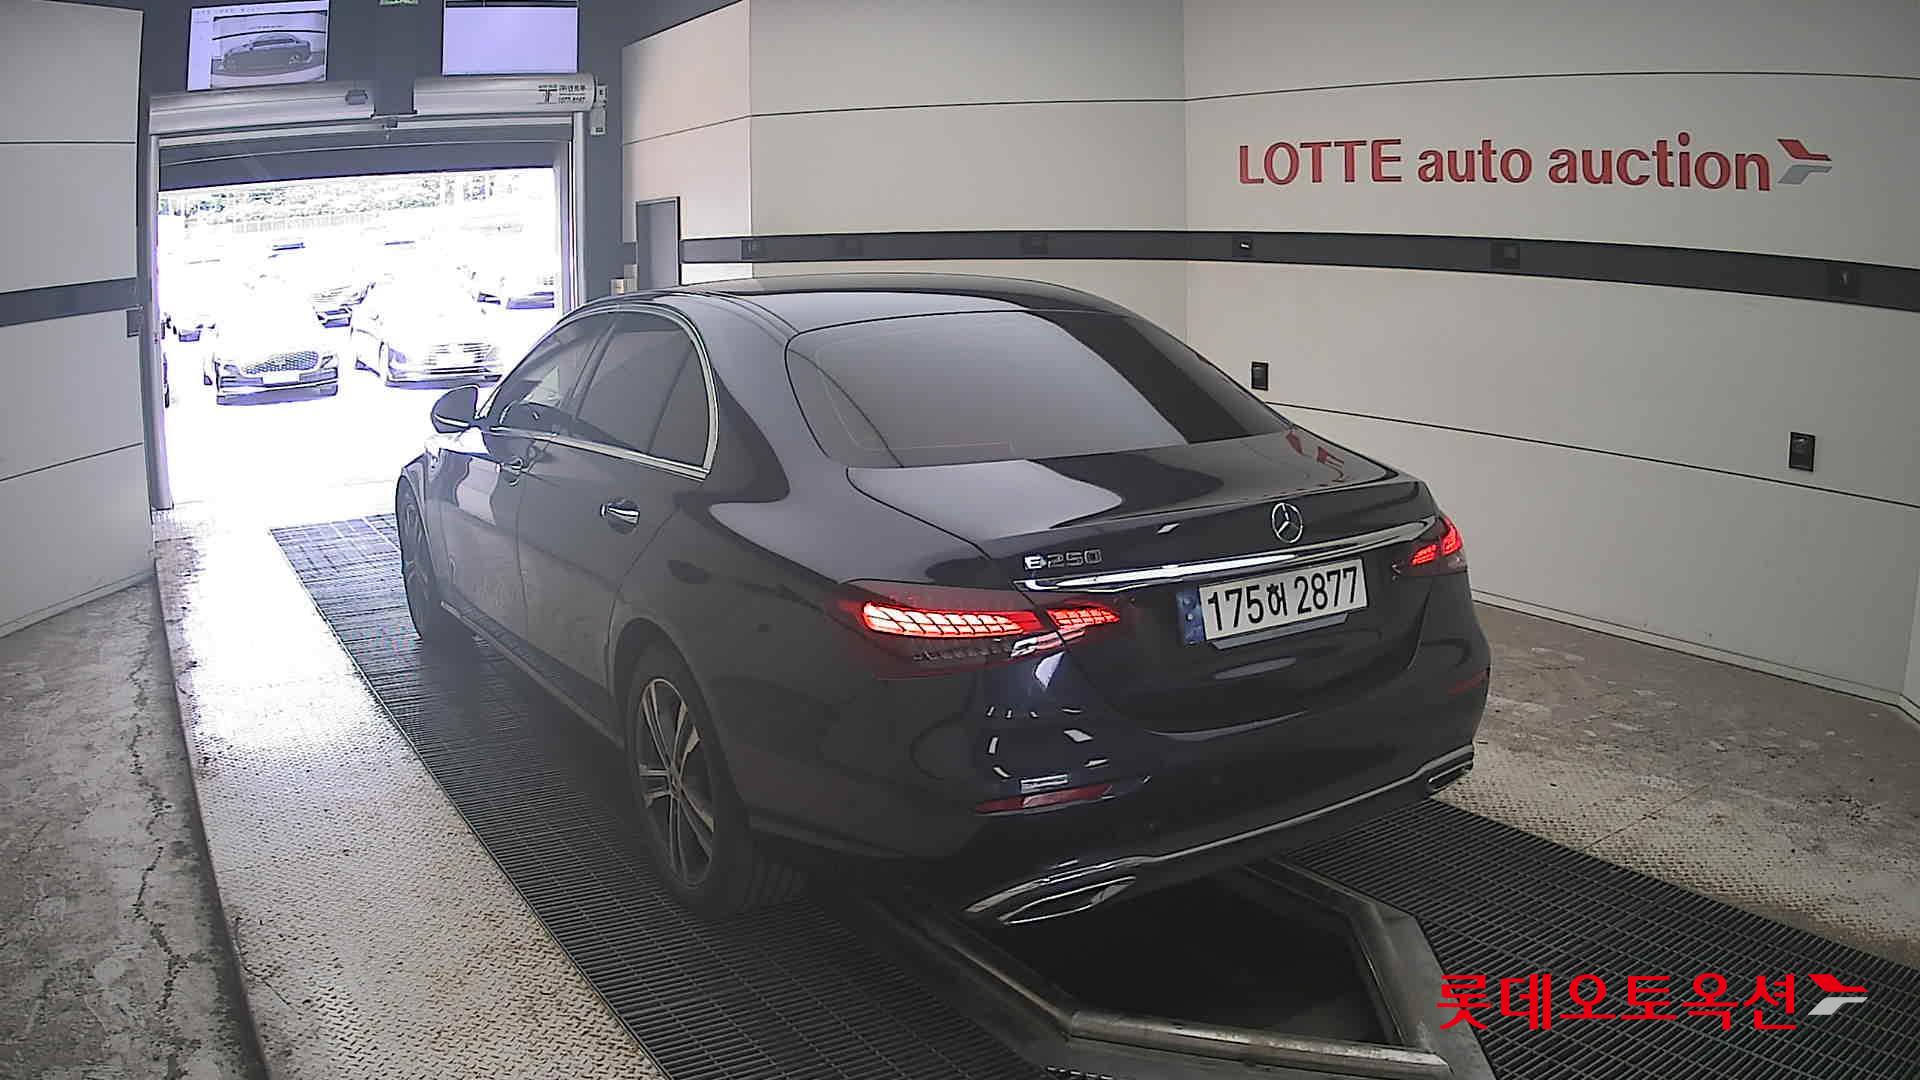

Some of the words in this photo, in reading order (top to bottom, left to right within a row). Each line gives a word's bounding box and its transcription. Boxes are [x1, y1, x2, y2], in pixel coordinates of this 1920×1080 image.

[1239, 138, 1402, 185] LOTTE
[1417, 139, 1532, 183] auto
[1548, 132, 1771, 191] auction
[1207, 583, 1288, 631] 175허
[1294, 566, 1357, 615] 2877
